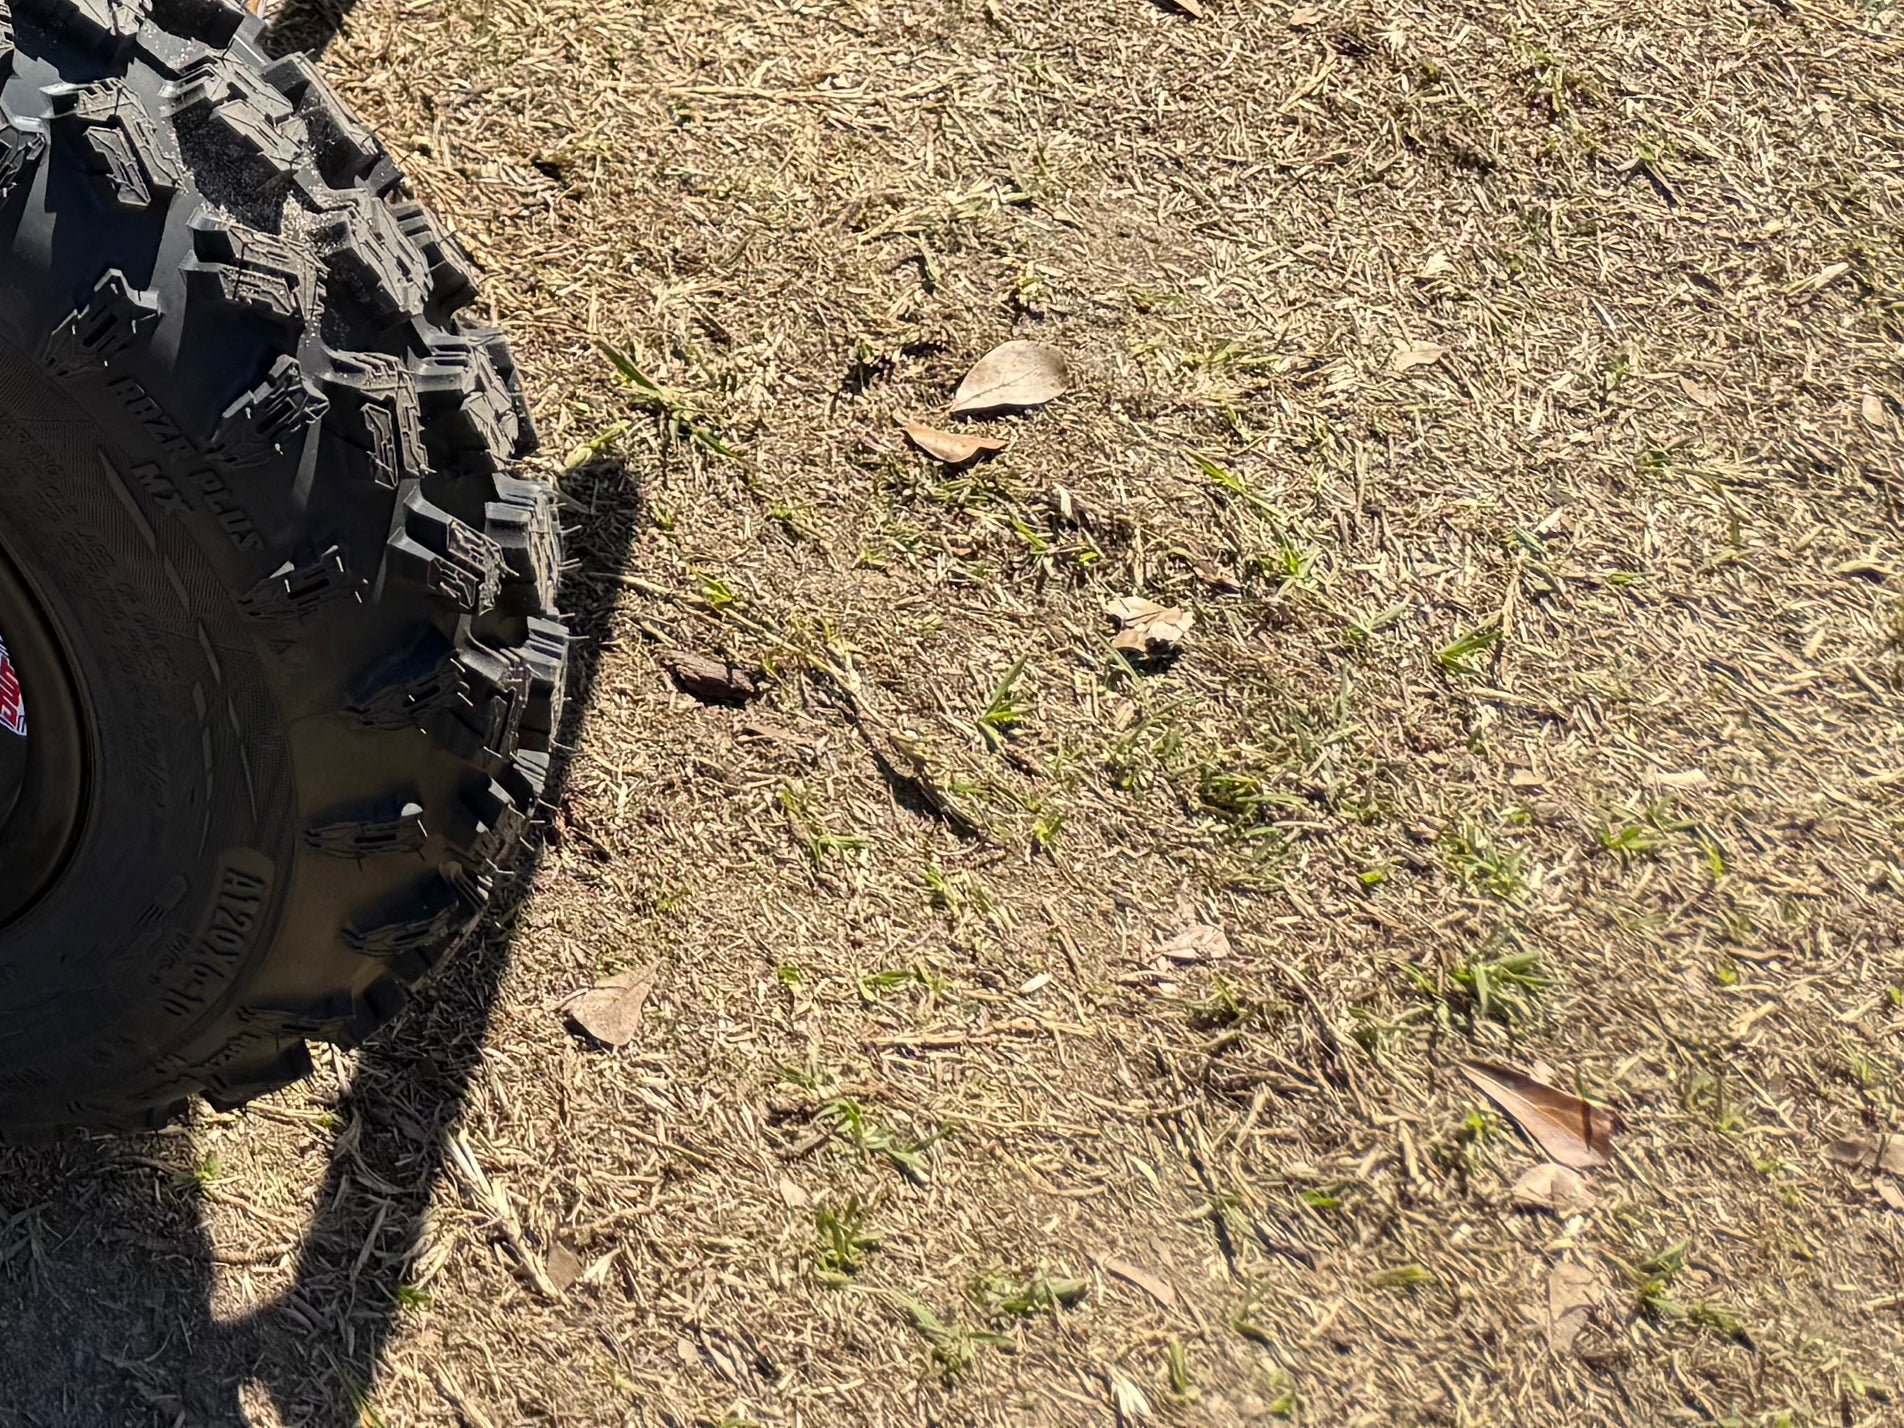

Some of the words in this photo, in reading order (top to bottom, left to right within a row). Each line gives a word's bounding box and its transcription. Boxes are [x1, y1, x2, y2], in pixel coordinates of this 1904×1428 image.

[107, 376, 197, 468] RAZR
[191, 465, 265, 554] PLUS
[132, 460, 194, 514] MX
